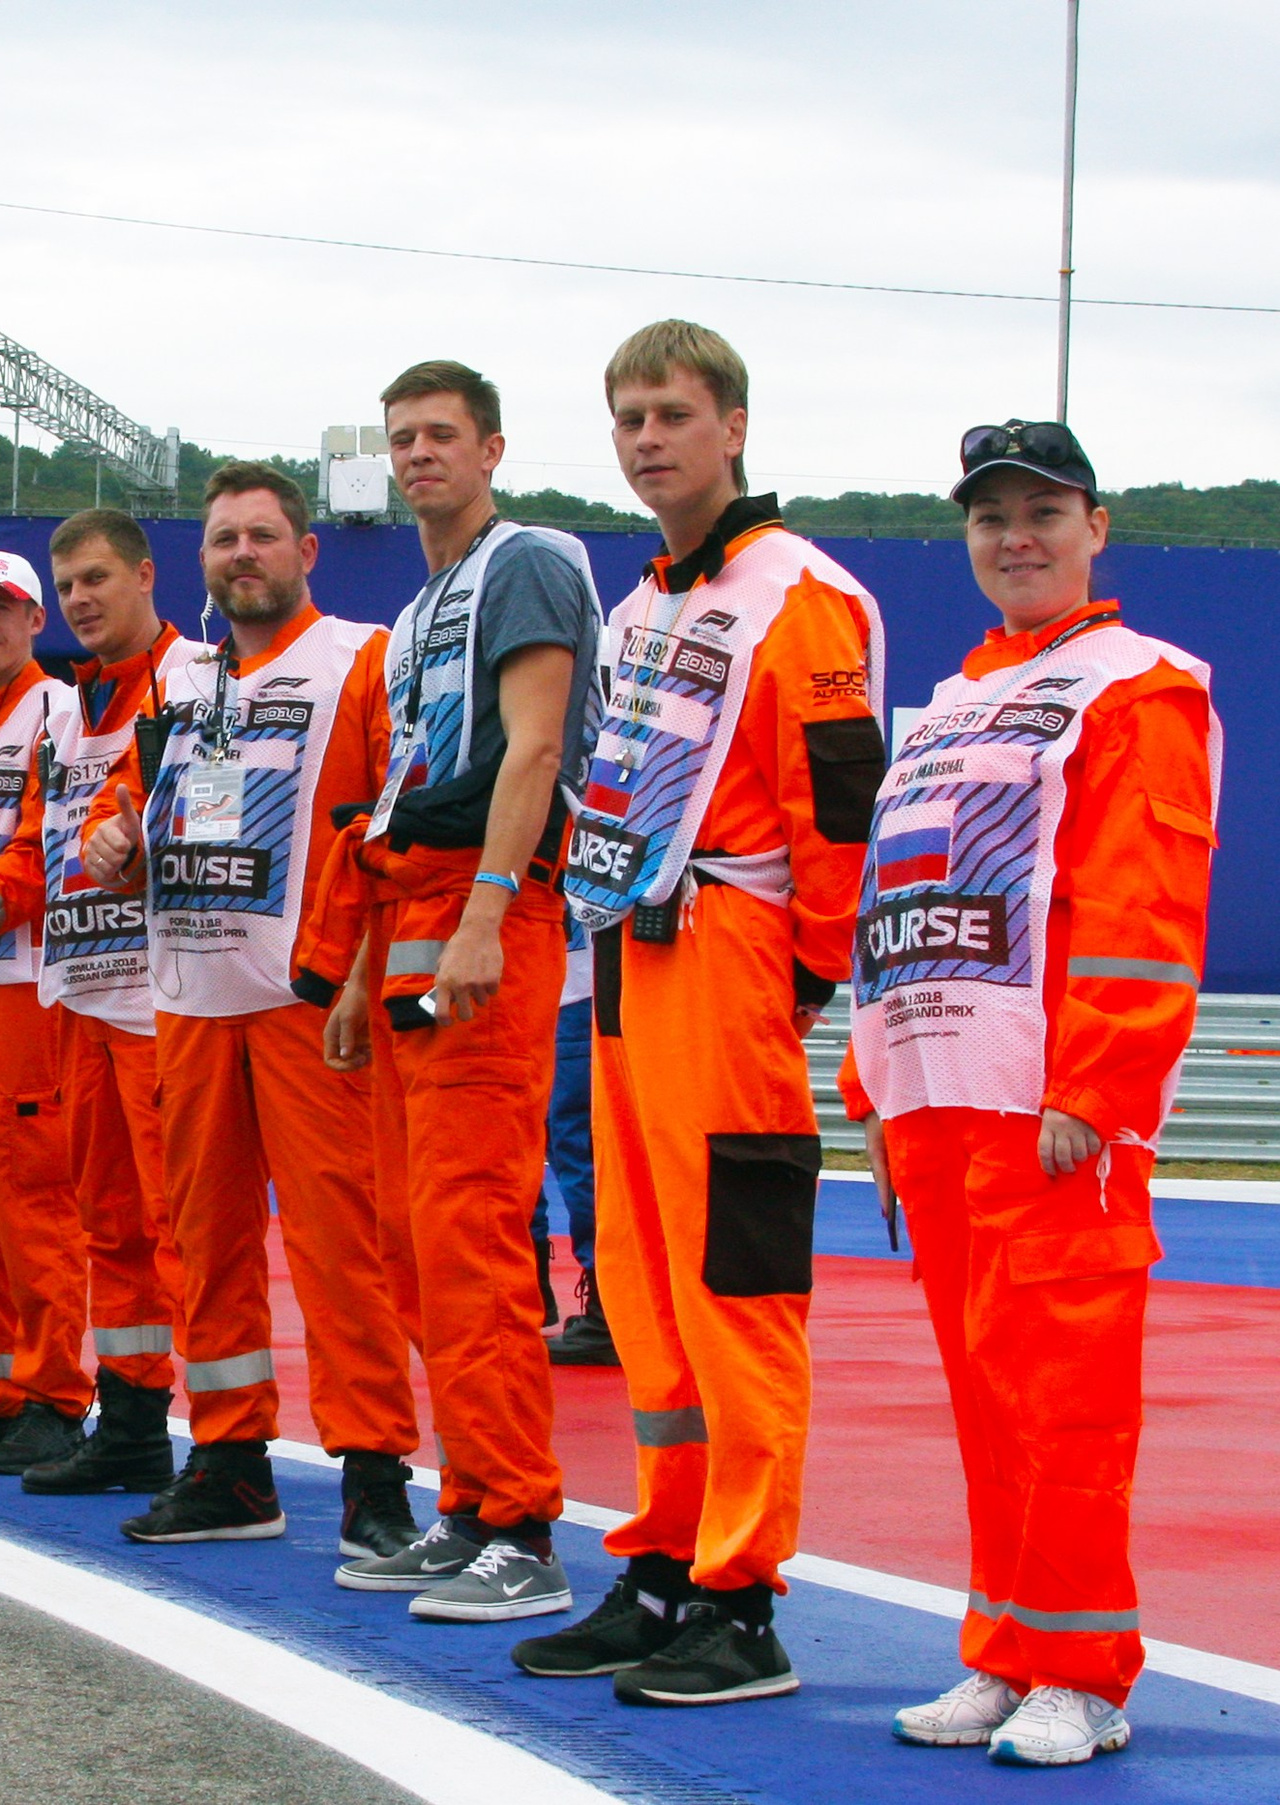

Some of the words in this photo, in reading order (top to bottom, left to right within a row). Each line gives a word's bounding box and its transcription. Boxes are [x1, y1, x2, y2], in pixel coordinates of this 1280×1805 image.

[810, 670, 864, 688] SOC
[254, 707, 307, 723] 2018
[995, 708, 1065, 733] 2018
[915, 759, 965, 780] MARSHAL
[567, 828, 634, 880] URSE
[47, 900, 145, 936] COURS
[224, 928, 249, 939] PRIX
[867, 905, 990, 960] OURSE
[112, 957, 137, 967] 2018
[101, 967, 137, 979] GRAND
[914, 991, 943, 1005] 2018
[945, 1004, 976, 1018] PRIX
